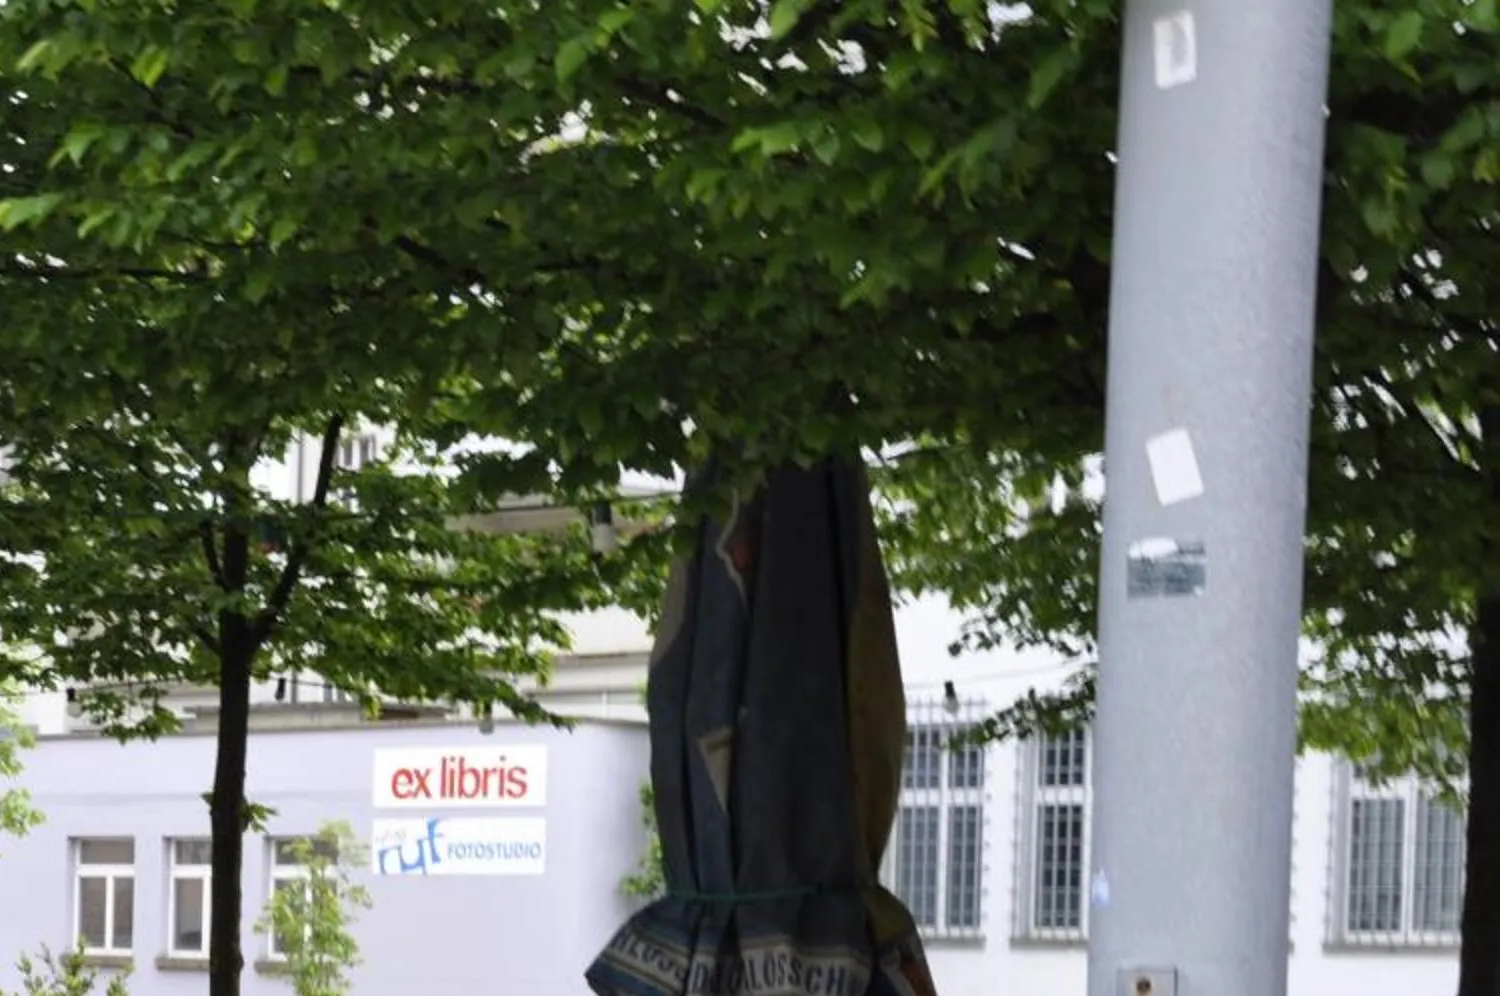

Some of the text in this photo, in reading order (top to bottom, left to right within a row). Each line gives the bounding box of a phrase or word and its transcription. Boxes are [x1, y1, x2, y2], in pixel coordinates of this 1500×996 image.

[390, 754, 528, 800] ex libris
[447, 841, 542, 861] FOTOSTUDIO
